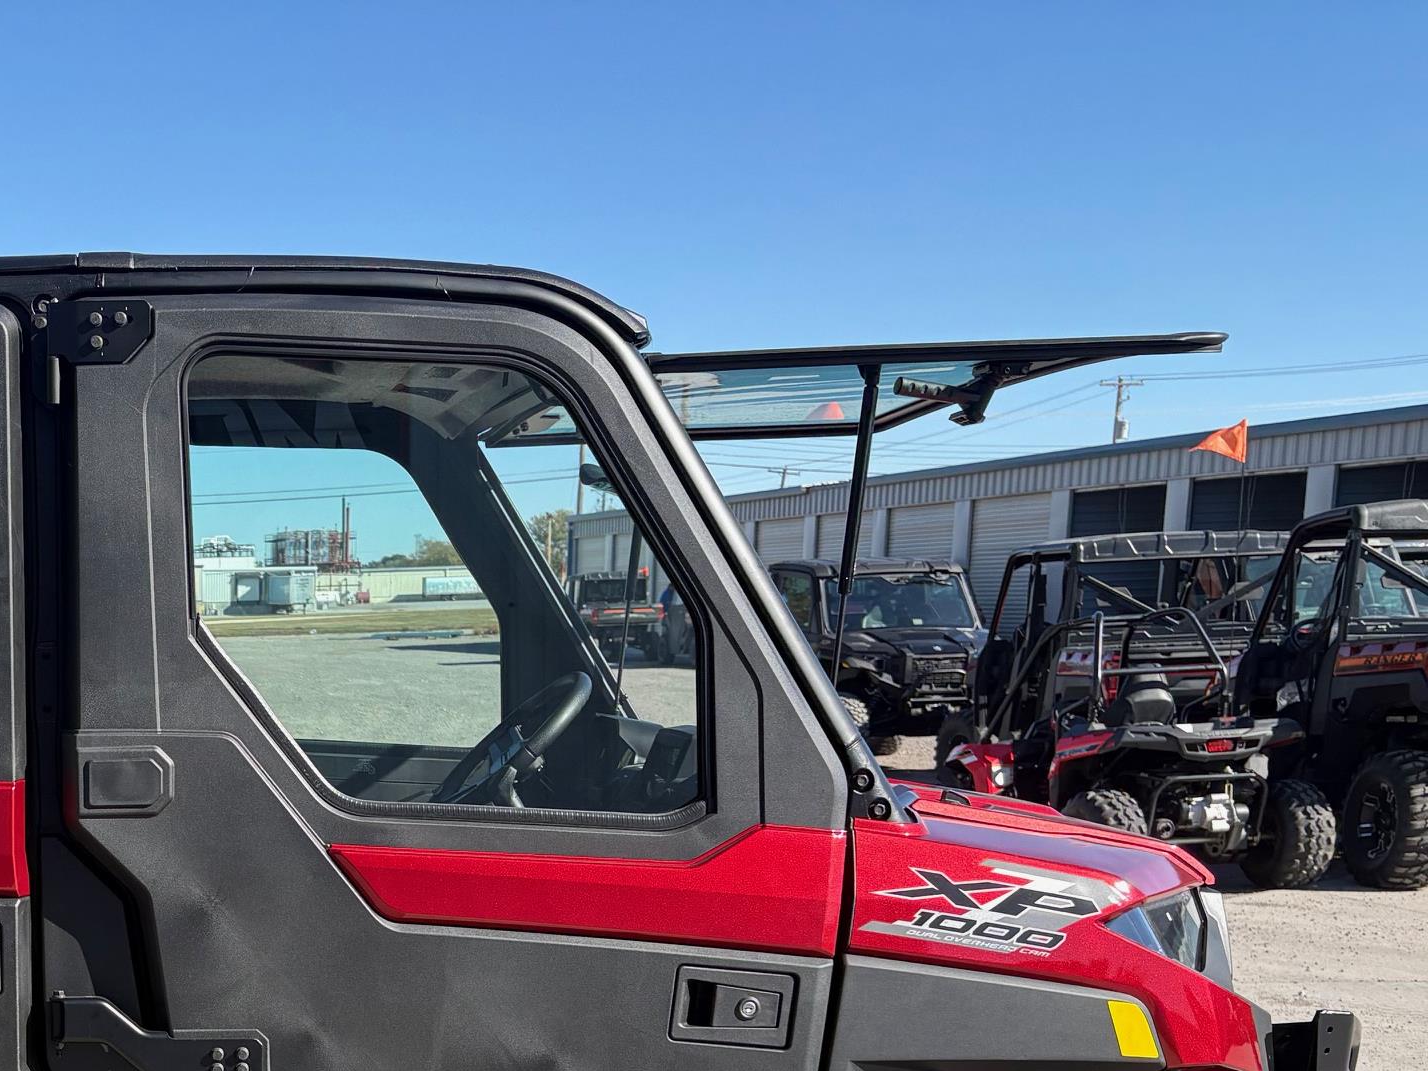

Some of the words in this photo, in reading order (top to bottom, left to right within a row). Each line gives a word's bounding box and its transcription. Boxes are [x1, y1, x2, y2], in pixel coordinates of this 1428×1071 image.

[871, 866, 1101, 918] XP
[906, 929, 942, 940] DUAL
[944, 934, 1020, 952] OVERHEAD
[1019, 947, 1051, 957] CAM
[910, 909, 1067, 950] 1000
